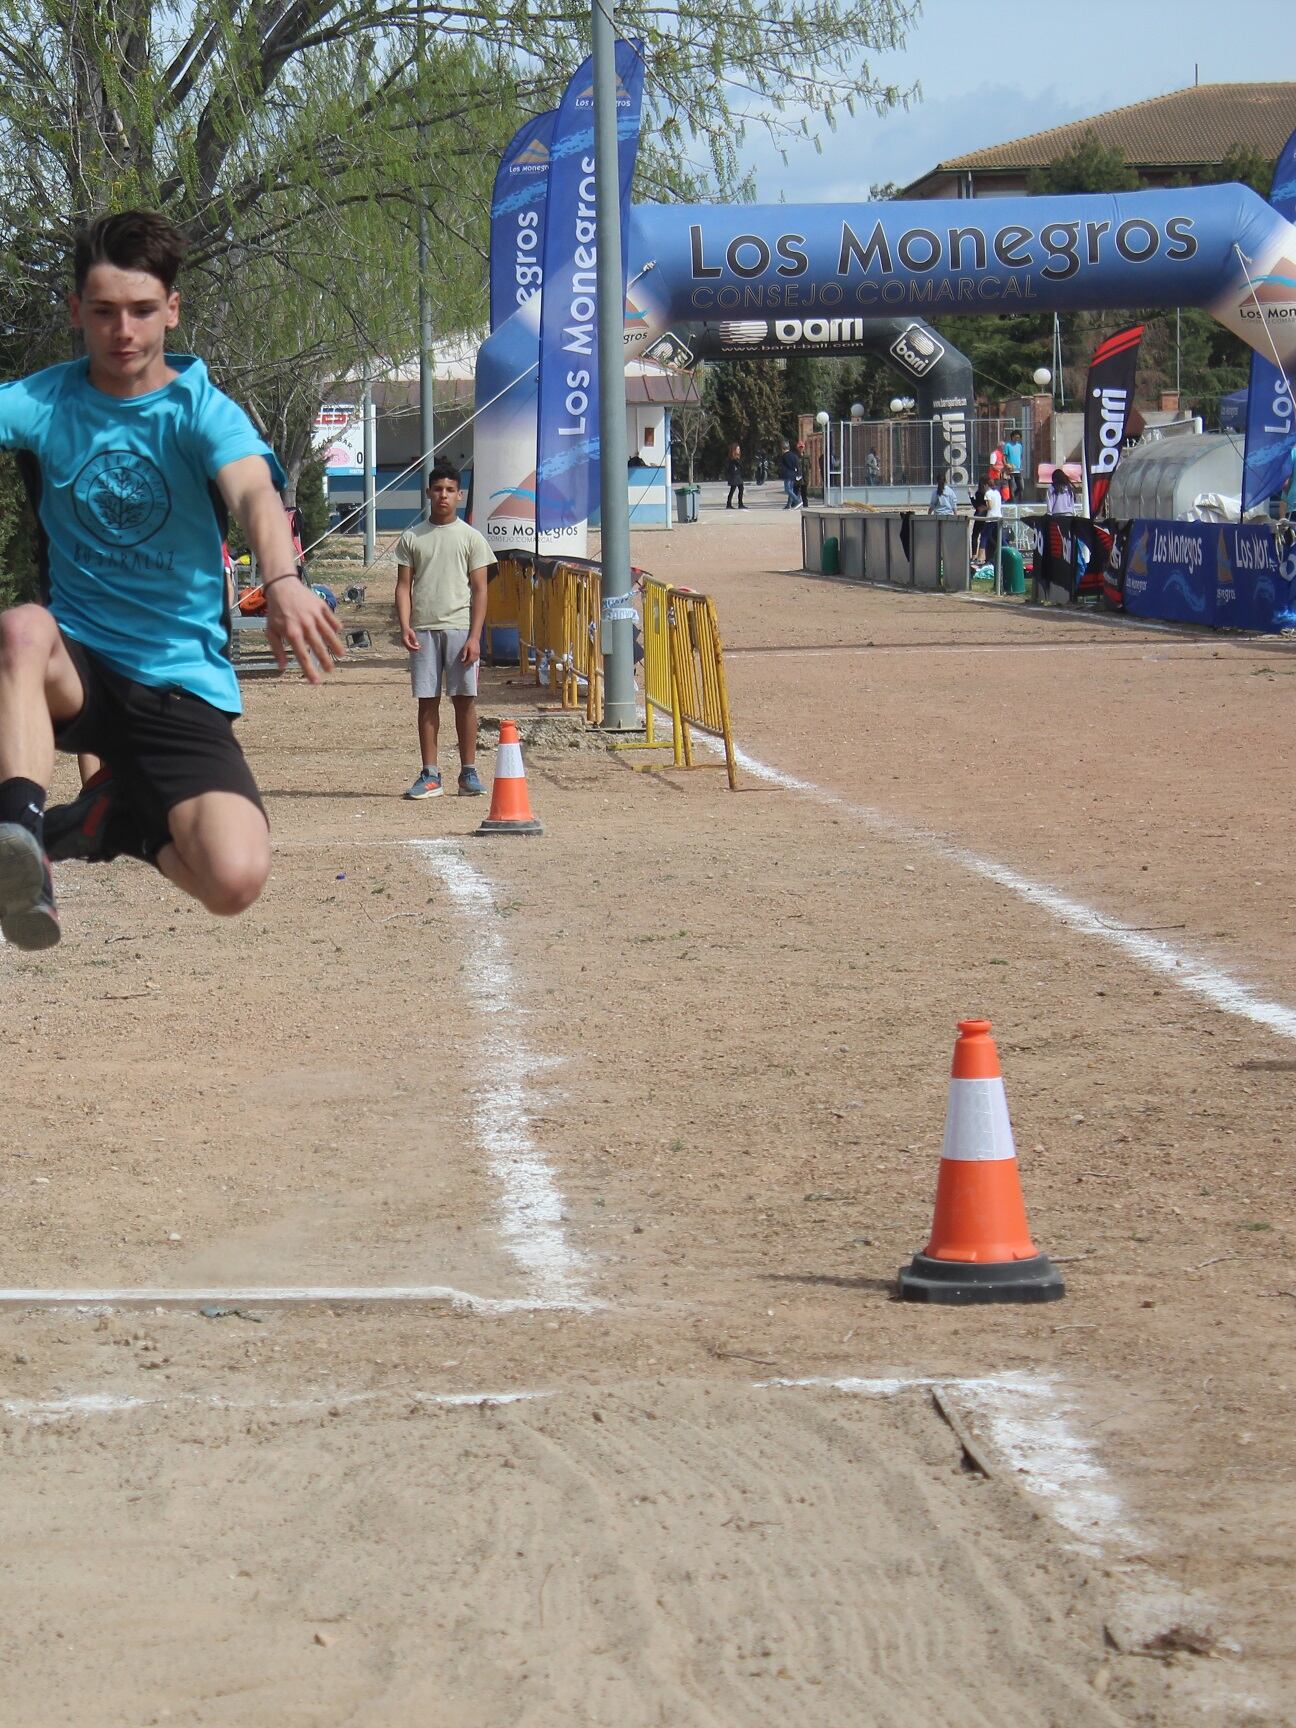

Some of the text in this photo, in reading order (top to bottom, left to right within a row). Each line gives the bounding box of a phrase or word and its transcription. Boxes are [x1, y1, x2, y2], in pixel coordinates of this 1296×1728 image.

[516, 211, 543, 306] egros
[688, 217, 1198, 281] Los Monegros
[691, 275, 1037, 309] CONSEJO COMARCAL
[1240, 309, 1263, 319] Los
[623, 331, 648, 345] gros
[896, 339, 930, 372] barri
[558, 369, 590, 436] Los
[1264, 379, 1293, 434] Los
[1091, 388, 1127, 474] barri
[487, 523, 578, 539] Los Moegros
[1153, 528, 1167, 563] Los
[1168, 530, 1203, 574] Monegros
[1235, 530, 1253, 569] Los
